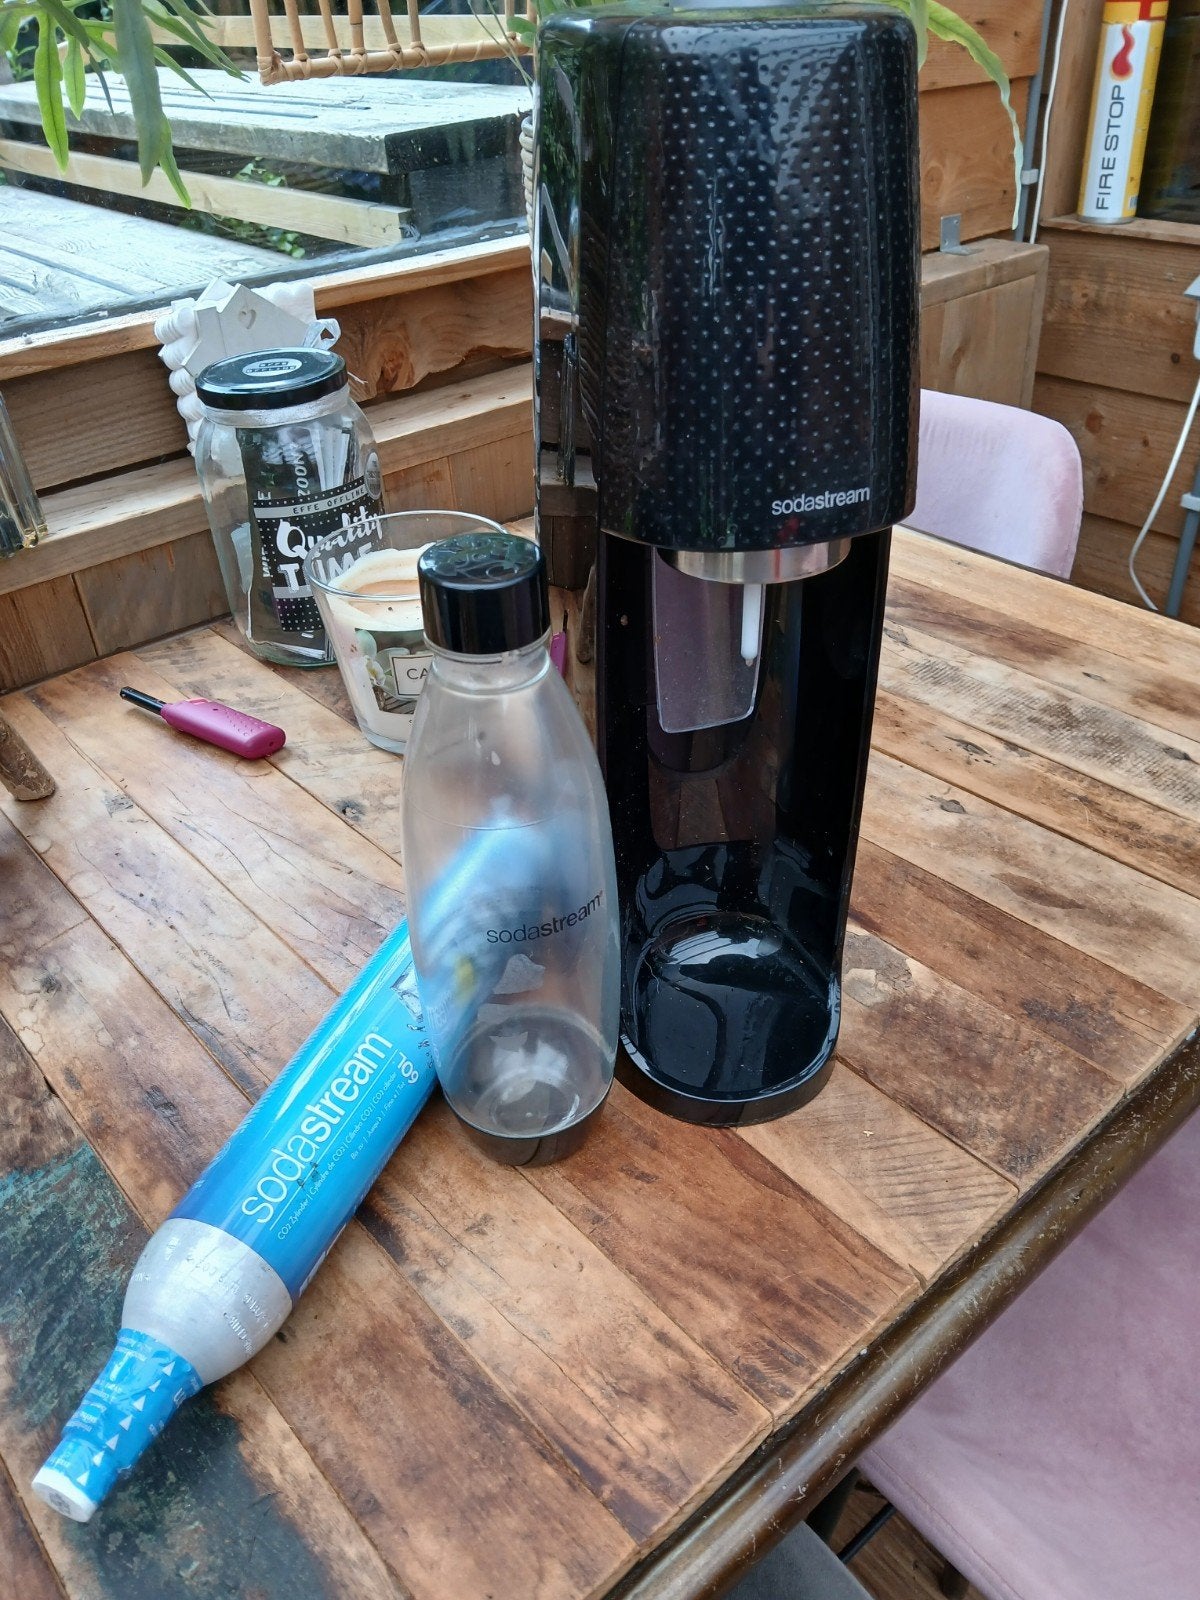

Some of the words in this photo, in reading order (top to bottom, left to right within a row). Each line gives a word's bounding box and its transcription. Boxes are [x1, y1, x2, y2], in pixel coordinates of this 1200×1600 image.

[1105, 84, 1125, 151] STOP
[1096, 156, 1116, 210] FIRE
[292, 503, 320, 515] EFFE
[327, 488, 365, 507] OFFLINE
[771, 486, 871, 515] sodastream
[276, 505, 383, 560] Quality
[486, 893, 602, 943] sodastream
[241, 1032, 394, 1224] sodastream
